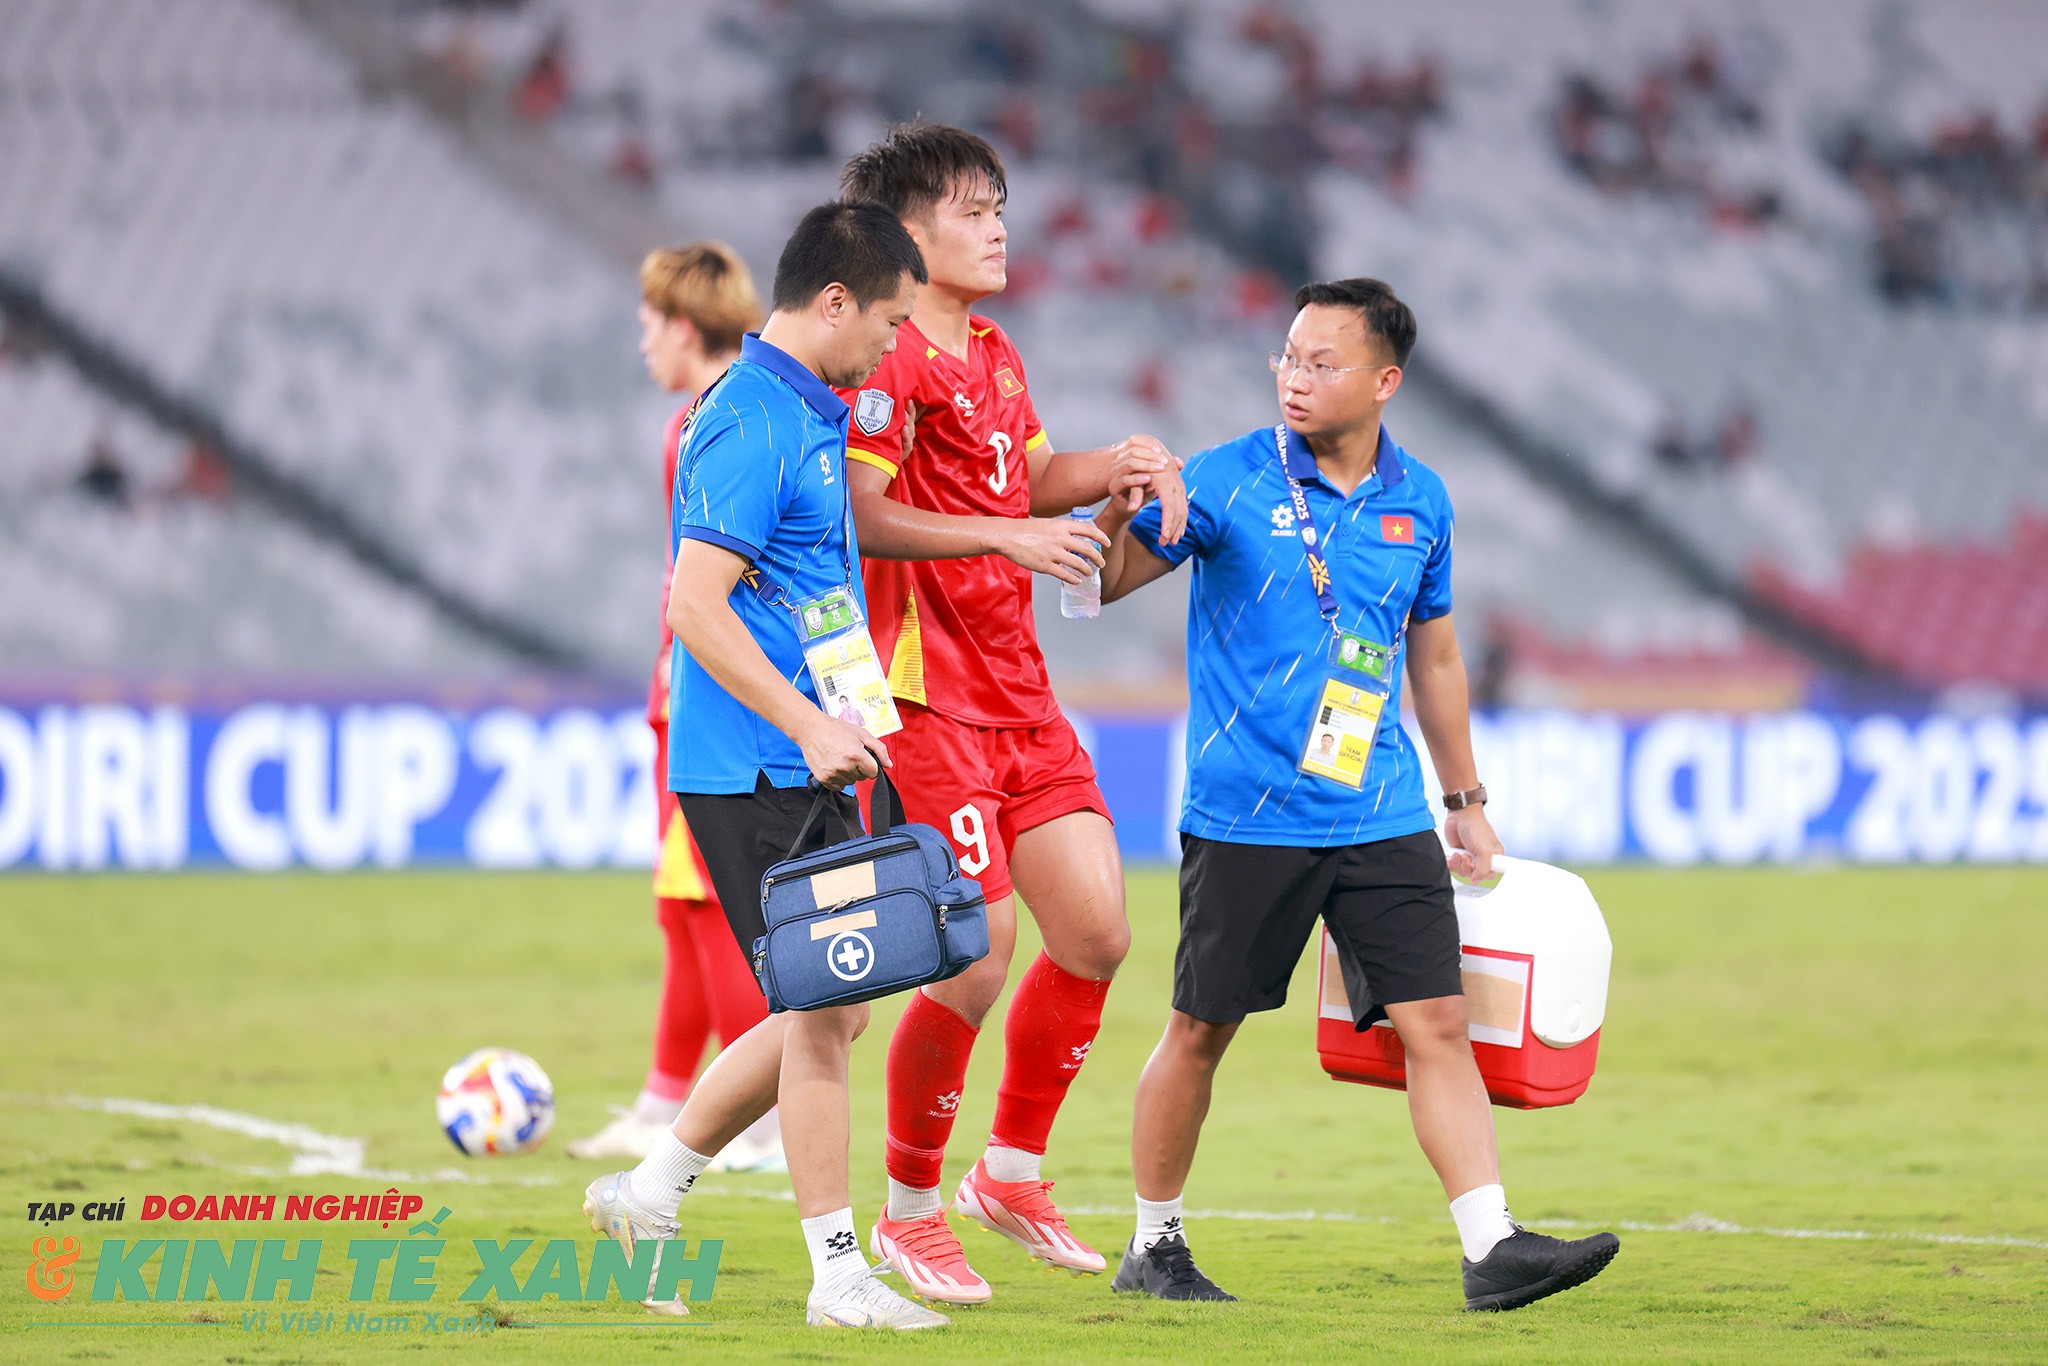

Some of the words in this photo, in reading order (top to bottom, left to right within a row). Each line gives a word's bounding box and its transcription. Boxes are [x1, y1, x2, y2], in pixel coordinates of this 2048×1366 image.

[1291, 489, 1310, 520] 2025
[1339, 751, 1363, 763] OFFICIAL
[1346, 746, 1361, 755] TEAM
[205, 704, 457, 870] CUP
[1630, 711, 1843, 866] CUP
[950, 803, 991, 876] 9
